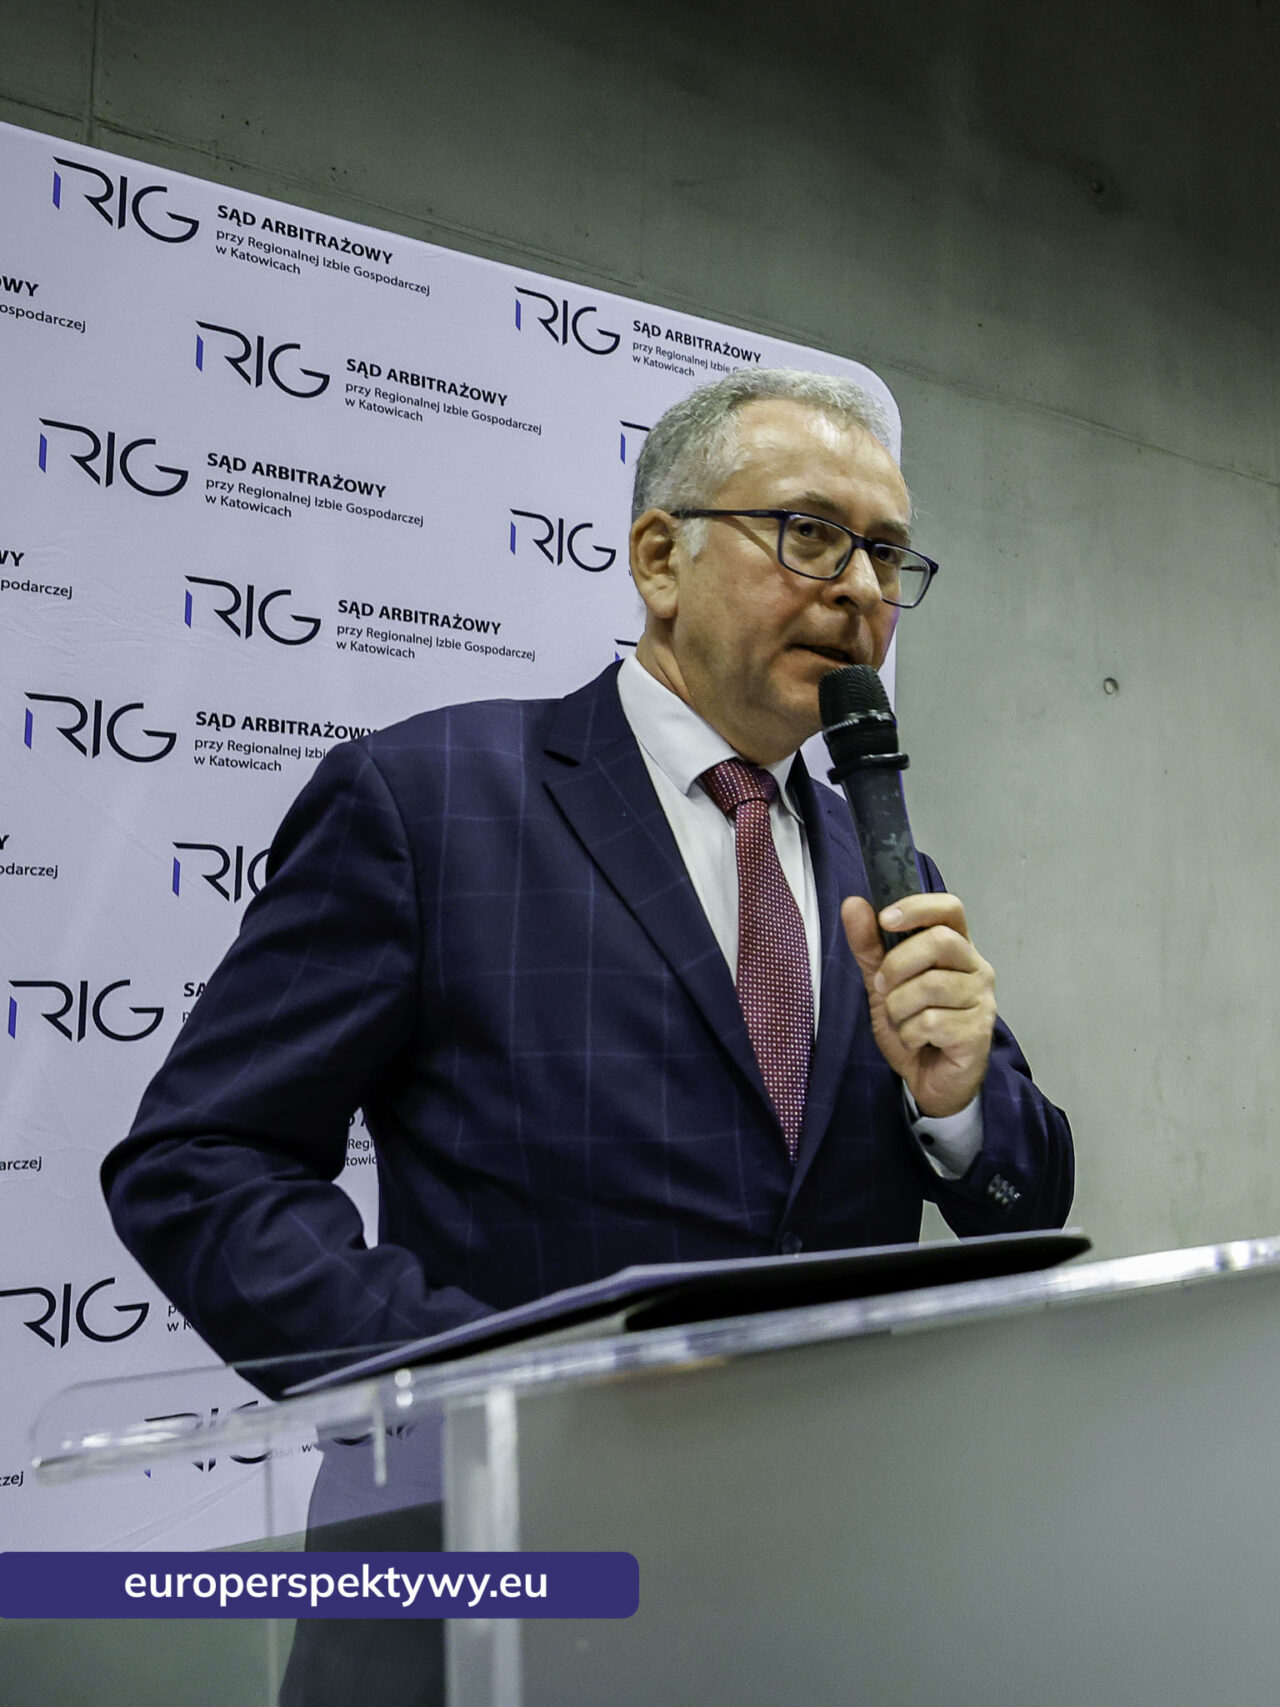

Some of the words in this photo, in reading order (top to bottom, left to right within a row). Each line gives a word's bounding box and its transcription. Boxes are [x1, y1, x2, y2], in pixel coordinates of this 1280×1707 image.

[53, 156, 199, 243] RIG
[217, 205, 256, 227] SĄD
[261, 218, 393, 265] ARBITRAŻOWY
[215, 245, 227, 255] w
[230, 247, 301, 275] Katowicach
[216, 230, 244, 246] przy
[248, 236, 320, 267] Regionalnej
[322, 257, 351, 273] Izbie
[353, 266, 431, 296] Gospodarczej
[0, 275, 39, 297] WY
[514, 286, 621, 356] RIG
[633, 320, 661, 338] SĄD
[665, 329, 762, 363] ARBITRAŻOWY
[195, 320, 330, 398] RIG
[632, 342, 653, 355] przy
[655, 345, 708, 370] Regionalnej
[710, 360, 731, 373] Izbie
[632, 354, 640, 363] w
[643, 356, 695, 377] Katowicach
[346, 358, 382, 379] SĄD
[386, 368, 508, 407] ARBITRAŻOWY
[345, 383, 371, 397] przy
[374, 387, 440, 413] Regionalnej
[443, 403, 468, 418] Izbie
[471, 410, 542, 436] Gospodarczej
[345, 397, 355, 407] w
[358, 400, 423, 422] Katowicach
[38, 418, 189, 497] RIG
[207, 452, 246, 474] SĄD
[252, 461, 387, 498] ARBITRAŻOWY
[205, 494, 217, 504] w
[220, 495, 292, 518] Katowicach
[206, 478, 235, 494] przy
[238, 483, 311, 507] Regionalnej
[314, 497, 343, 511] Izbie
[346, 503, 424, 528] Gospodarczej
[509, 507, 617, 573] RIG
[0, 579, 73, 600] podarczej
[184, 575, 322, 646] RIG
[338, 599, 374, 619] SĄD
[378, 605, 502, 636] ARBITRAŻOWY
[336, 641, 347, 650] w
[350, 641, 415, 659] Katowicach
[337, 625, 363, 639] przy
[366, 628, 433, 648] Regionalnej
[435, 636, 462, 650] Izbie
[464, 641, 536, 662] Gospodarczej
[24, 692, 177, 763] RIG
[195, 711, 236, 731] SĄD
[194, 755, 205, 765] w
[209, 755, 282, 772] Katowicach
[195, 739, 223, 752] przy
[228, 740, 301, 760] Regionalnej
[305, 747, 327, 759] Izbi
[8, 979, 165, 1042] RIG
